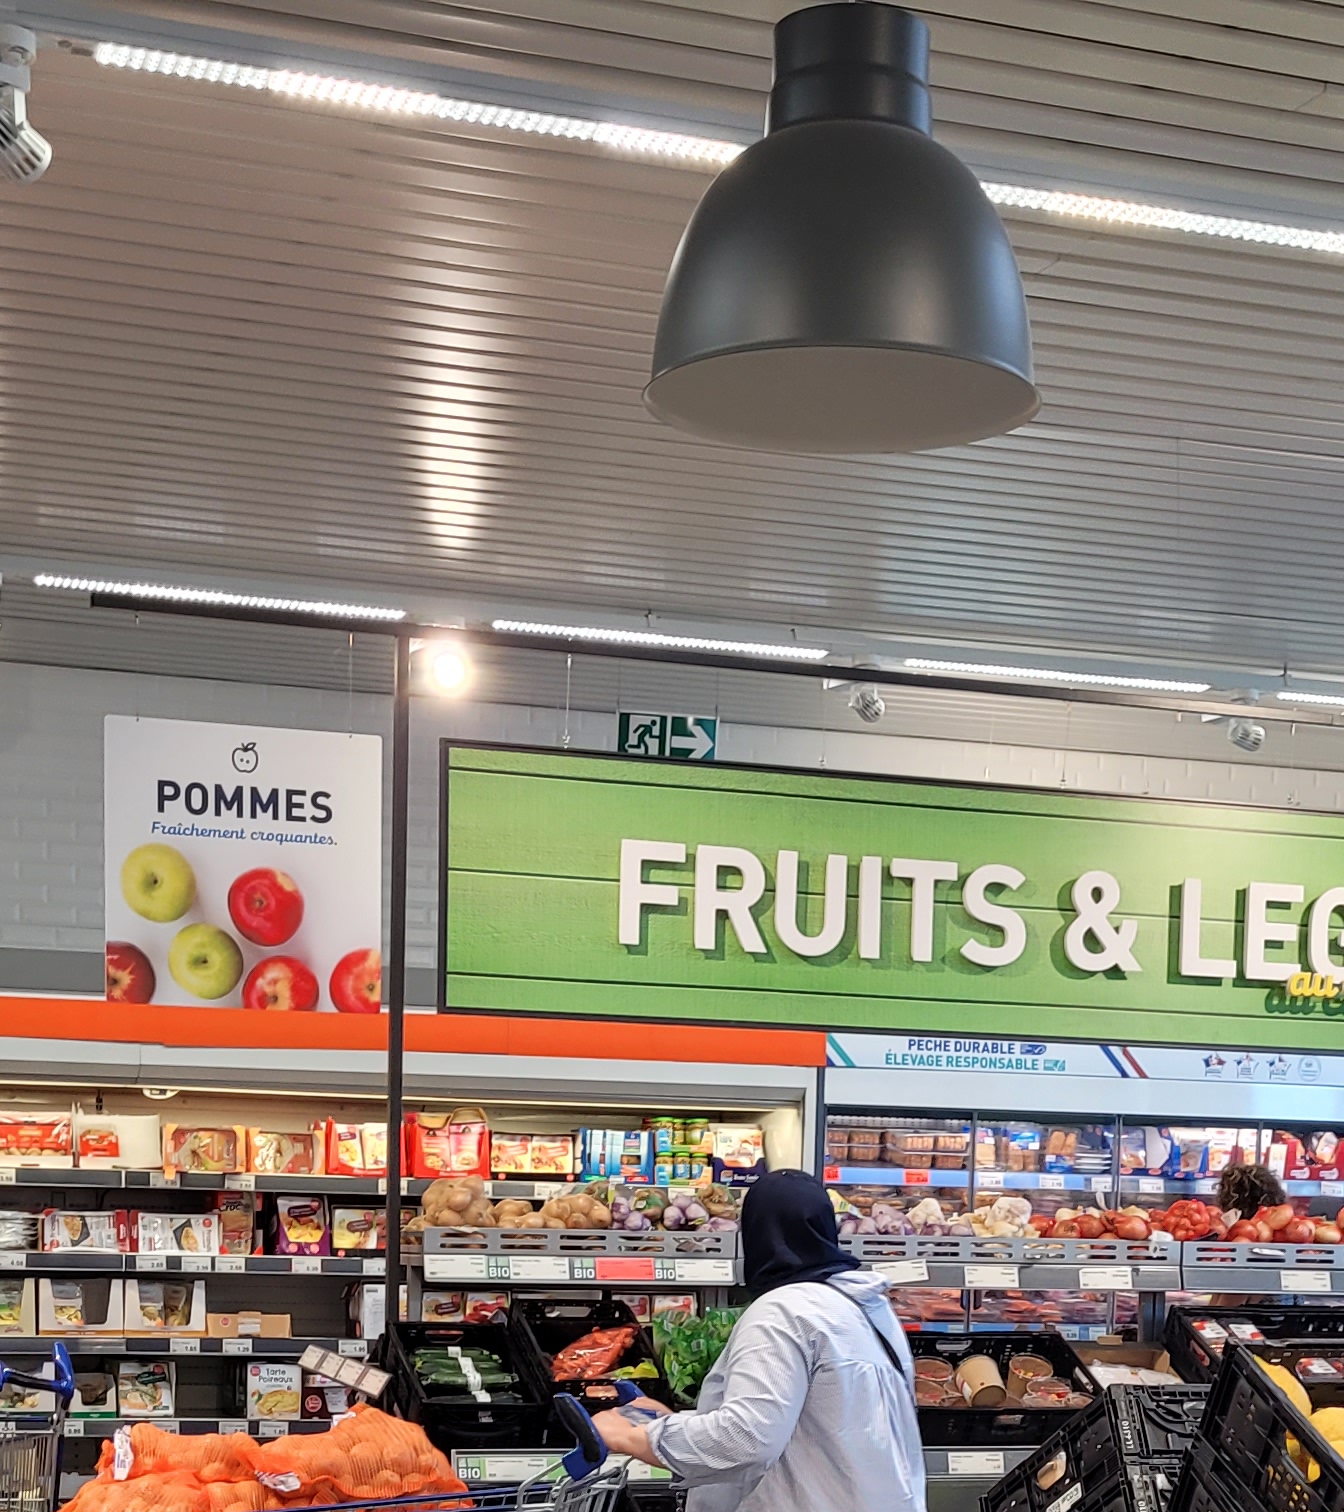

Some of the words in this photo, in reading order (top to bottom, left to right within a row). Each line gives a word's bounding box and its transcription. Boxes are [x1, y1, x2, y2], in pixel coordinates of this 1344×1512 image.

[157, 778, 334, 824] POMMES
[151, 821, 246, 840] Fraîchement
[250, 831, 338, 846] croquantes.
[618, 838, 1028, 969] FRUITS
[1062, 869, 1143, 976] &
[1287, 971, 1340, 999] au
[954, 1041, 1016, 1055] DURABLE
[884, 1049, 943, 1067] ÉLEVAGE
[945, 1055, 1039, 1071] RESPONSABLE
[488, 1267, 509, 1279] BIO
[574, 1267, 594, 1279] BIO
[655, 1268, 675, 1280] BIO
[458, 1467, 481, 1479] BIO
